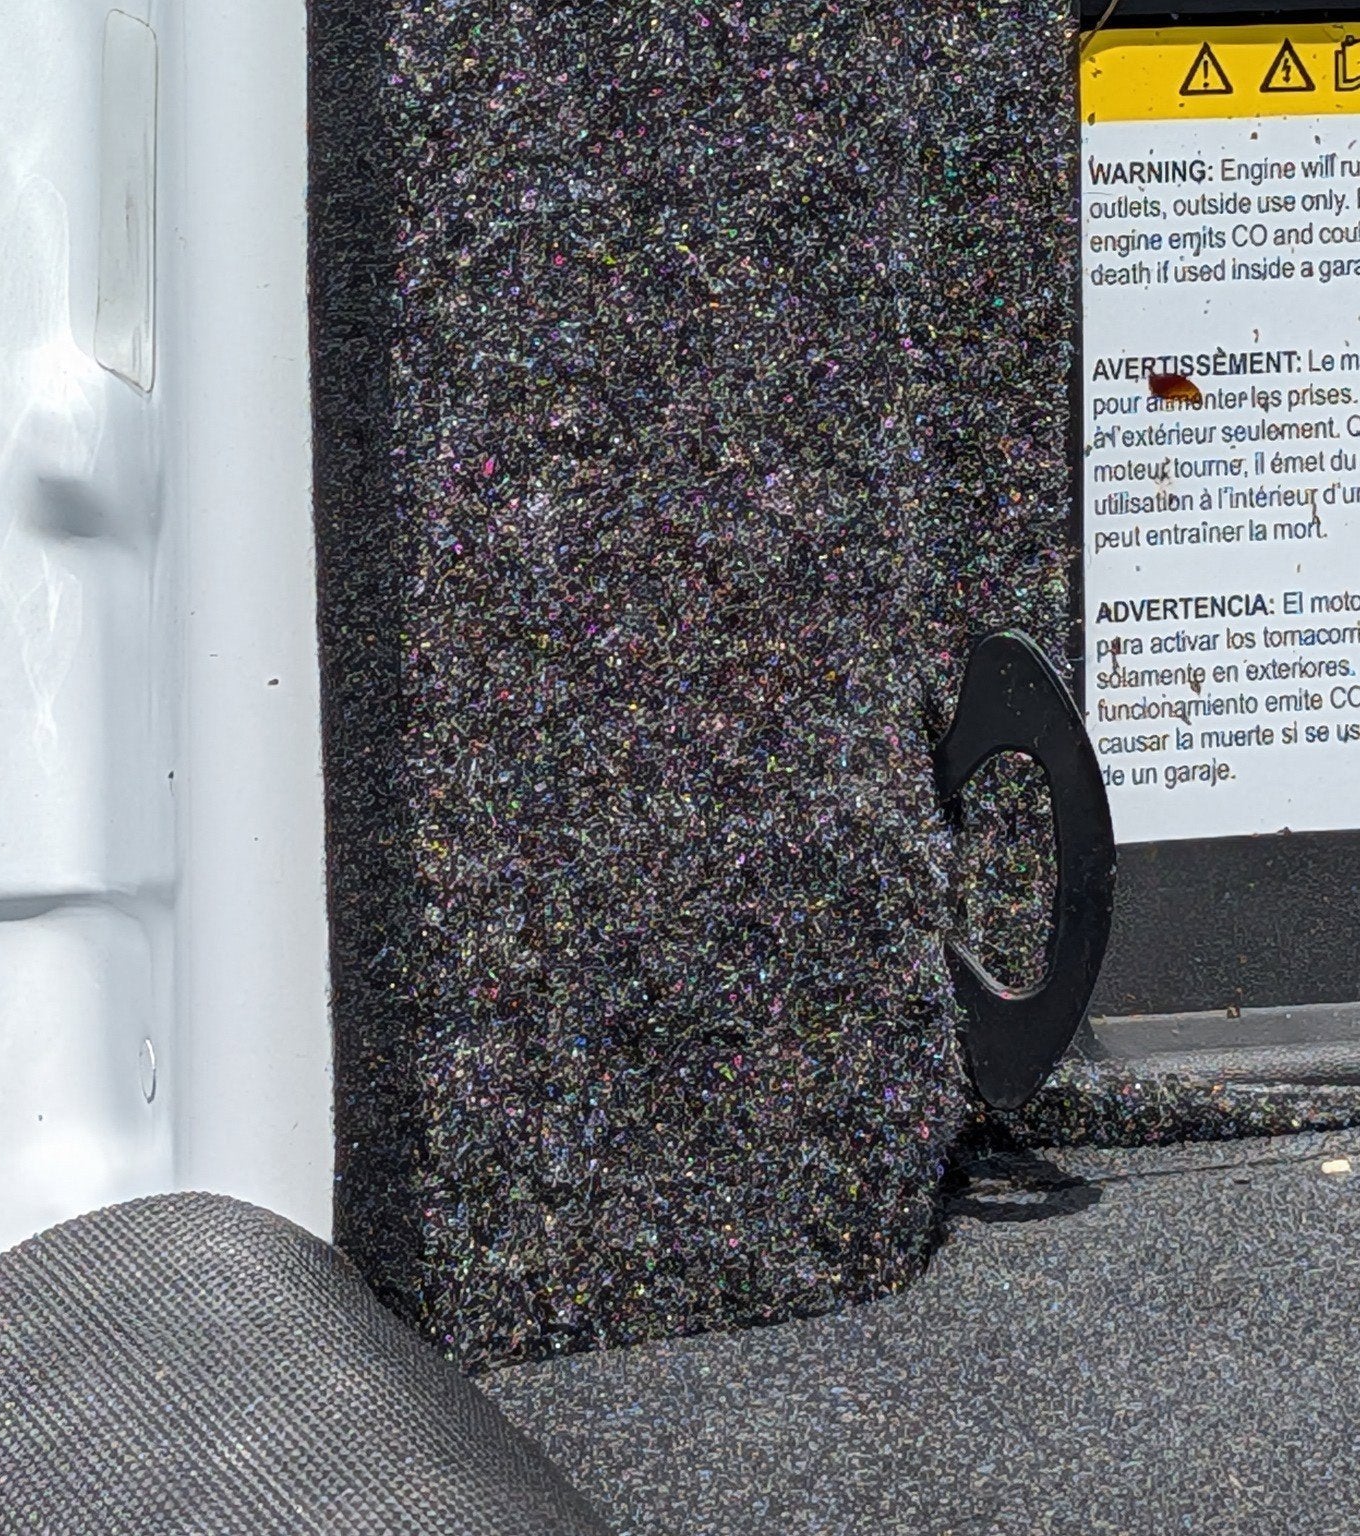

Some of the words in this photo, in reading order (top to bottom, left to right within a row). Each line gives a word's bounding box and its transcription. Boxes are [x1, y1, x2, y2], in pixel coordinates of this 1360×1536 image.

[1089, 160, 1214, 185] WARNING:
[1221, 158, 1295, 185] Engine
[1301, 154, 1336, 178] will
[1089, 196, 1167, 219] outlets,
[1173, 191, 1250, 215] outside
[1258, 194, 1295, 213] use
[1301, 188, 1349, 216] only.
[1090, 232, 1162, 257] engine
[1169, 228, 1225, 255] emits
[1232, 225, 1267, 247] CO
[1273, 222, 1313, 245] and
[1091, 262, 1150, 285] death
[1156, 261, 1169, 283] if
[1174, 259, 1223, 282] used
[1232, 258, 1294, 281] inside
[1300, 259, 1313, 278] a
[1309, 351, 1334, 372] Le
[1093, 397, 1141, 420] pour
[1252, 386, 1281, 410] les
[1288, 386, 1357, 410] prises.
[1093, 429, 1105, 448] à
[1111, 420, 1216, 447] l'extérieur
[1222, 417, 1340, 442] seulement.
[1093, 458, 1170, 482] moteur
[1174, 454, 1249, 477] tourne,
[1255, 452, 1265, 475] il
[1270, 451, 1324, 473] émet
[1330, 449, 1356, 471] du
[1094, 491, 1193, 515] utilisation
[1199, 491, 1212, 510] à
[1218, 485, 1317, 510] l'intérieur
[1095, 527, 1139, 553] peut
[1146, 520, 1242, 546] entraîner
[1249, 520, 1267, 541] la
[1274, 516, 1327, 540] mort.
[1096, 593, 1275, 624] ADVERTENCIA:
[1283, 592, 1303, 613] El
[1150, 630, 1219, 653] activar
[1226, 627, 1256, 650] los
[1213, 664, 1238, 682] en
[1246, 657, 1355, 681] exteriores.
[1097, 691, 1258, 722] funcionamiento
[1265, 689, 1322, 712] emite
[1098, 732, 1170, 755] causar
[1176, 729, 1193, 751] la
[1201, 726, 1274, 749] muerte
[1282, 722, 1298, 744] si
[1305, 722, 1329, 742] se
[1133, 767, 1157, 786] un
[1165, 758, 1235, 788] garaje.
